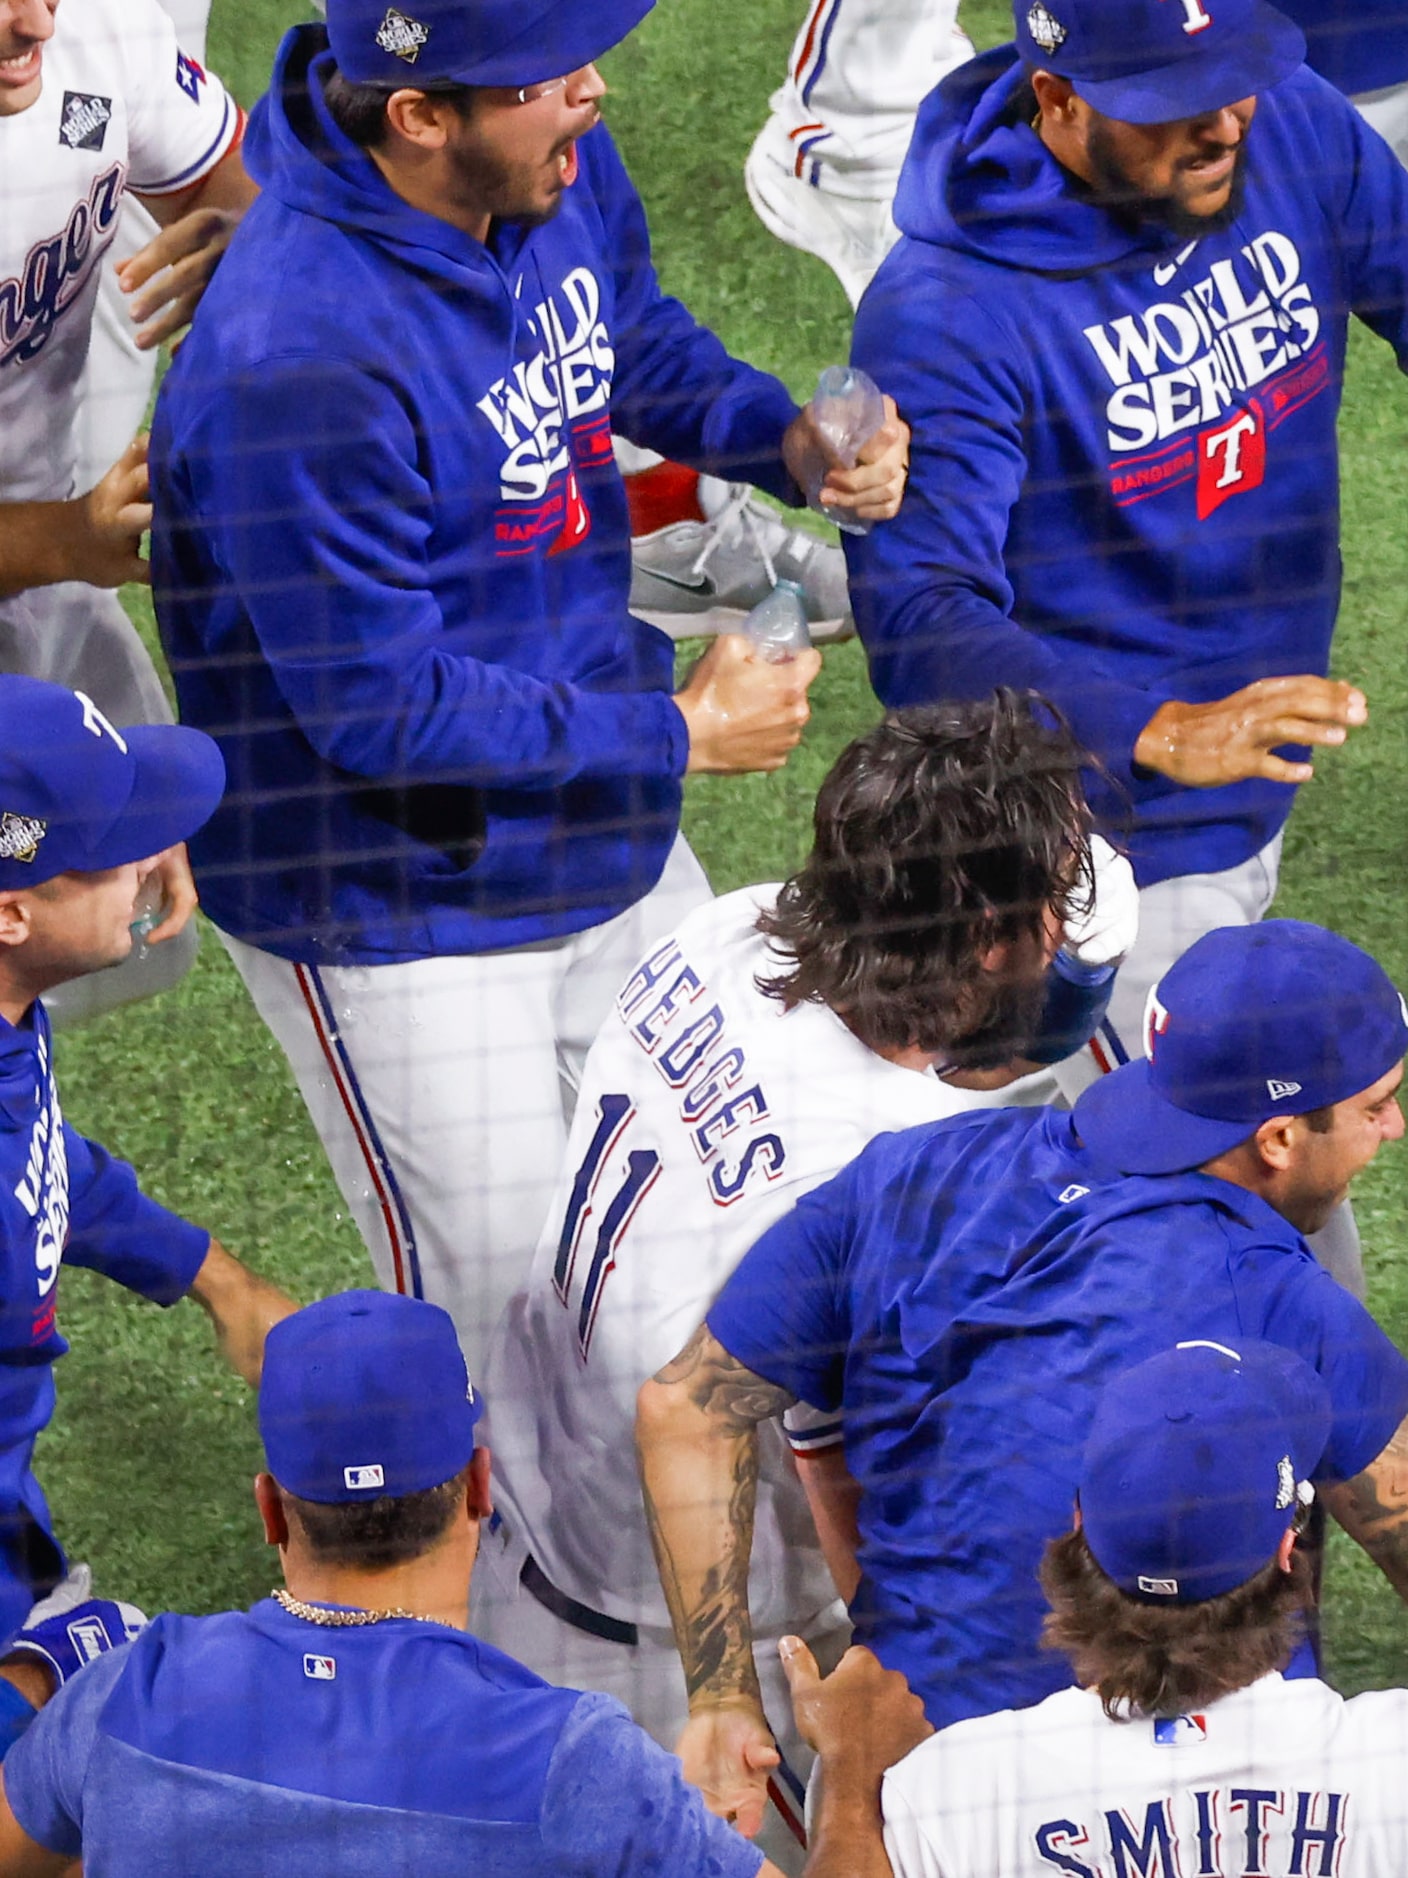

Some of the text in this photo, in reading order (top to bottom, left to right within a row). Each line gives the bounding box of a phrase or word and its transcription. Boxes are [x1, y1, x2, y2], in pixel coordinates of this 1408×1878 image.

[1083, 231, 1300, 387] WORLD
[1106, 283, 1320, 451] SERIES
[1206, 414, 1257, 490] T
[617, 938, 787, 1207] HEDGES
[551, 1093, 663, 1364] 11
[1035, 1788, 1350, 1878] SMITH
